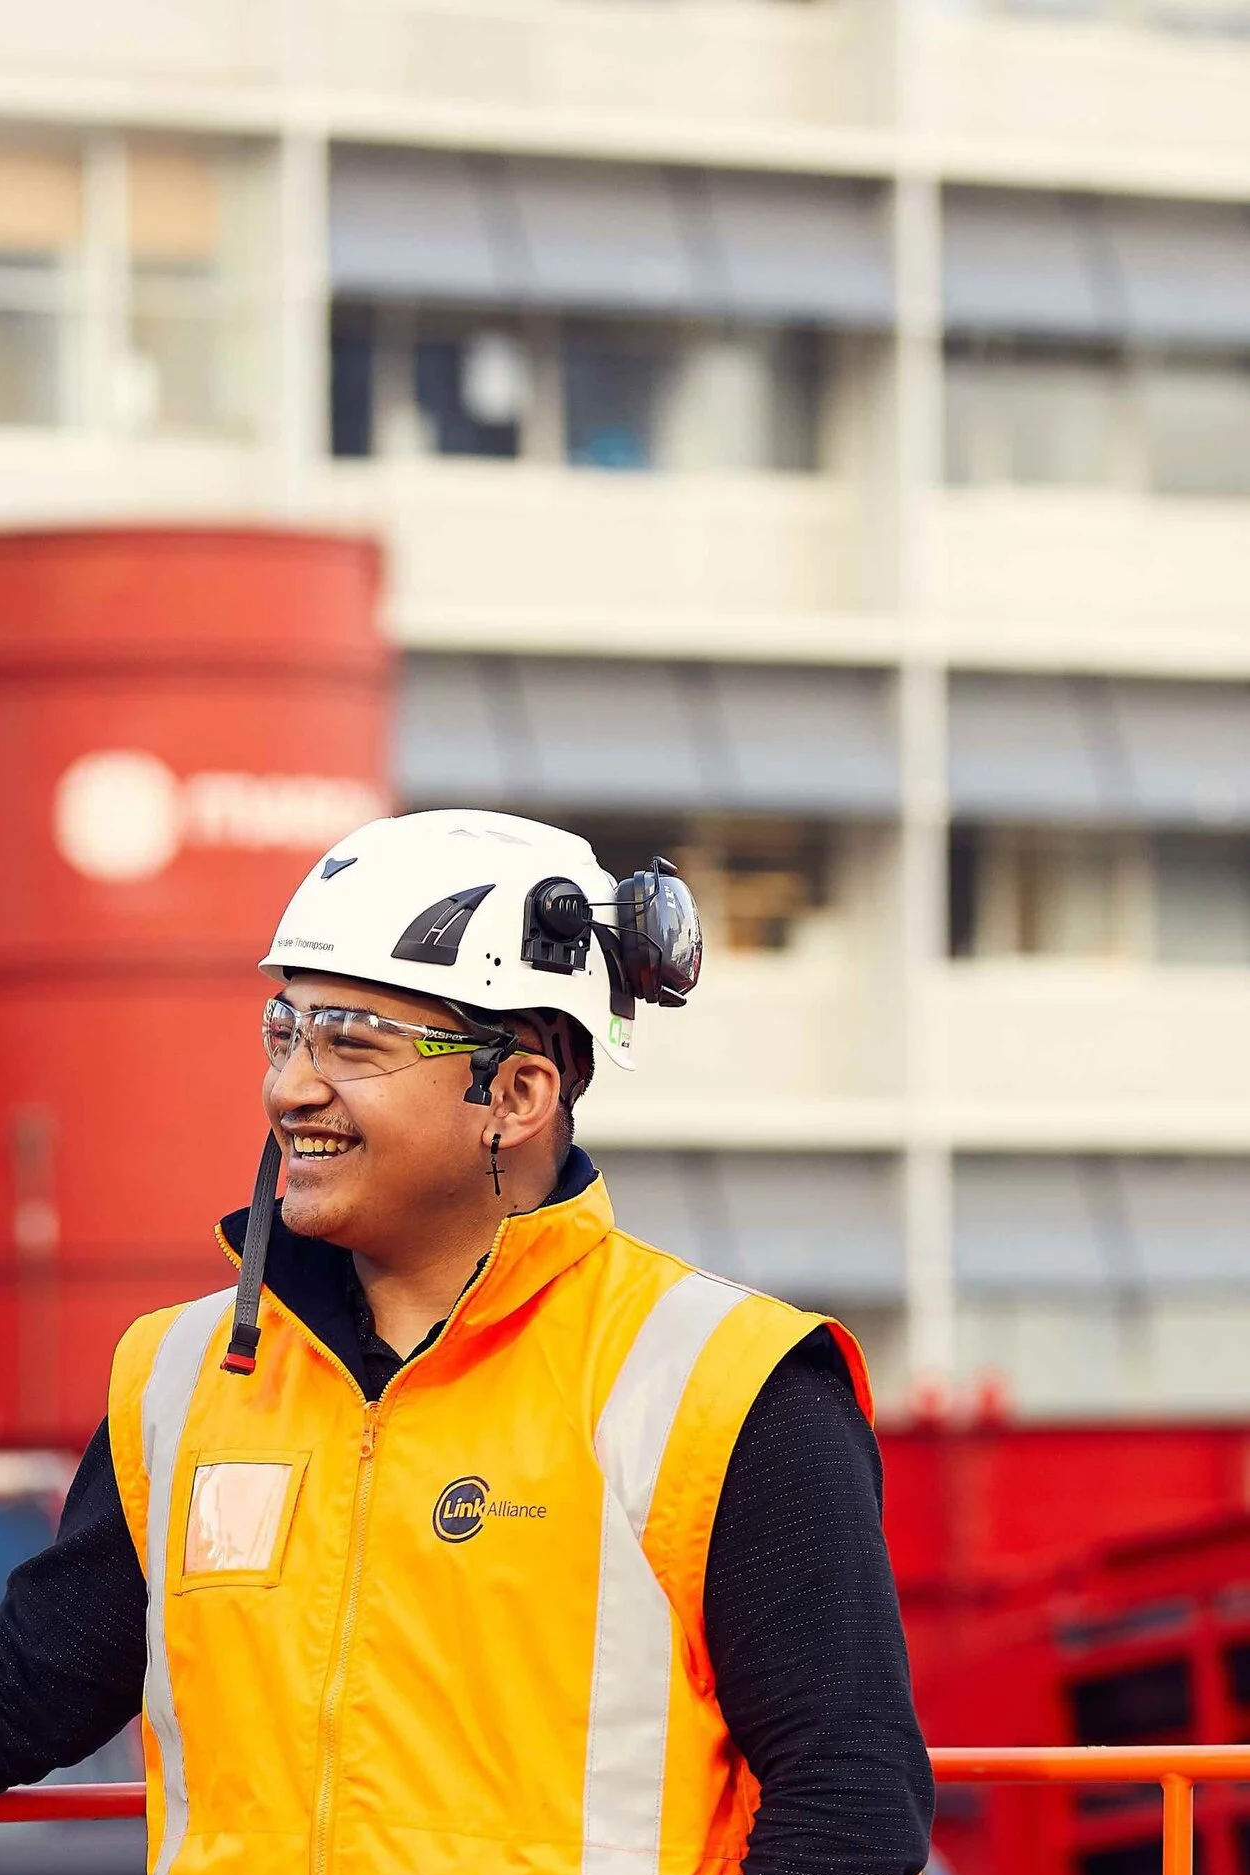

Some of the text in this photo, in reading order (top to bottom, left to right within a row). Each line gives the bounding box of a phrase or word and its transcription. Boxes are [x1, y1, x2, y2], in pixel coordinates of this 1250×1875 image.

[295, 937, 334, 951] Thompson
[443, 1497, 547, 1519] Link Alliance
